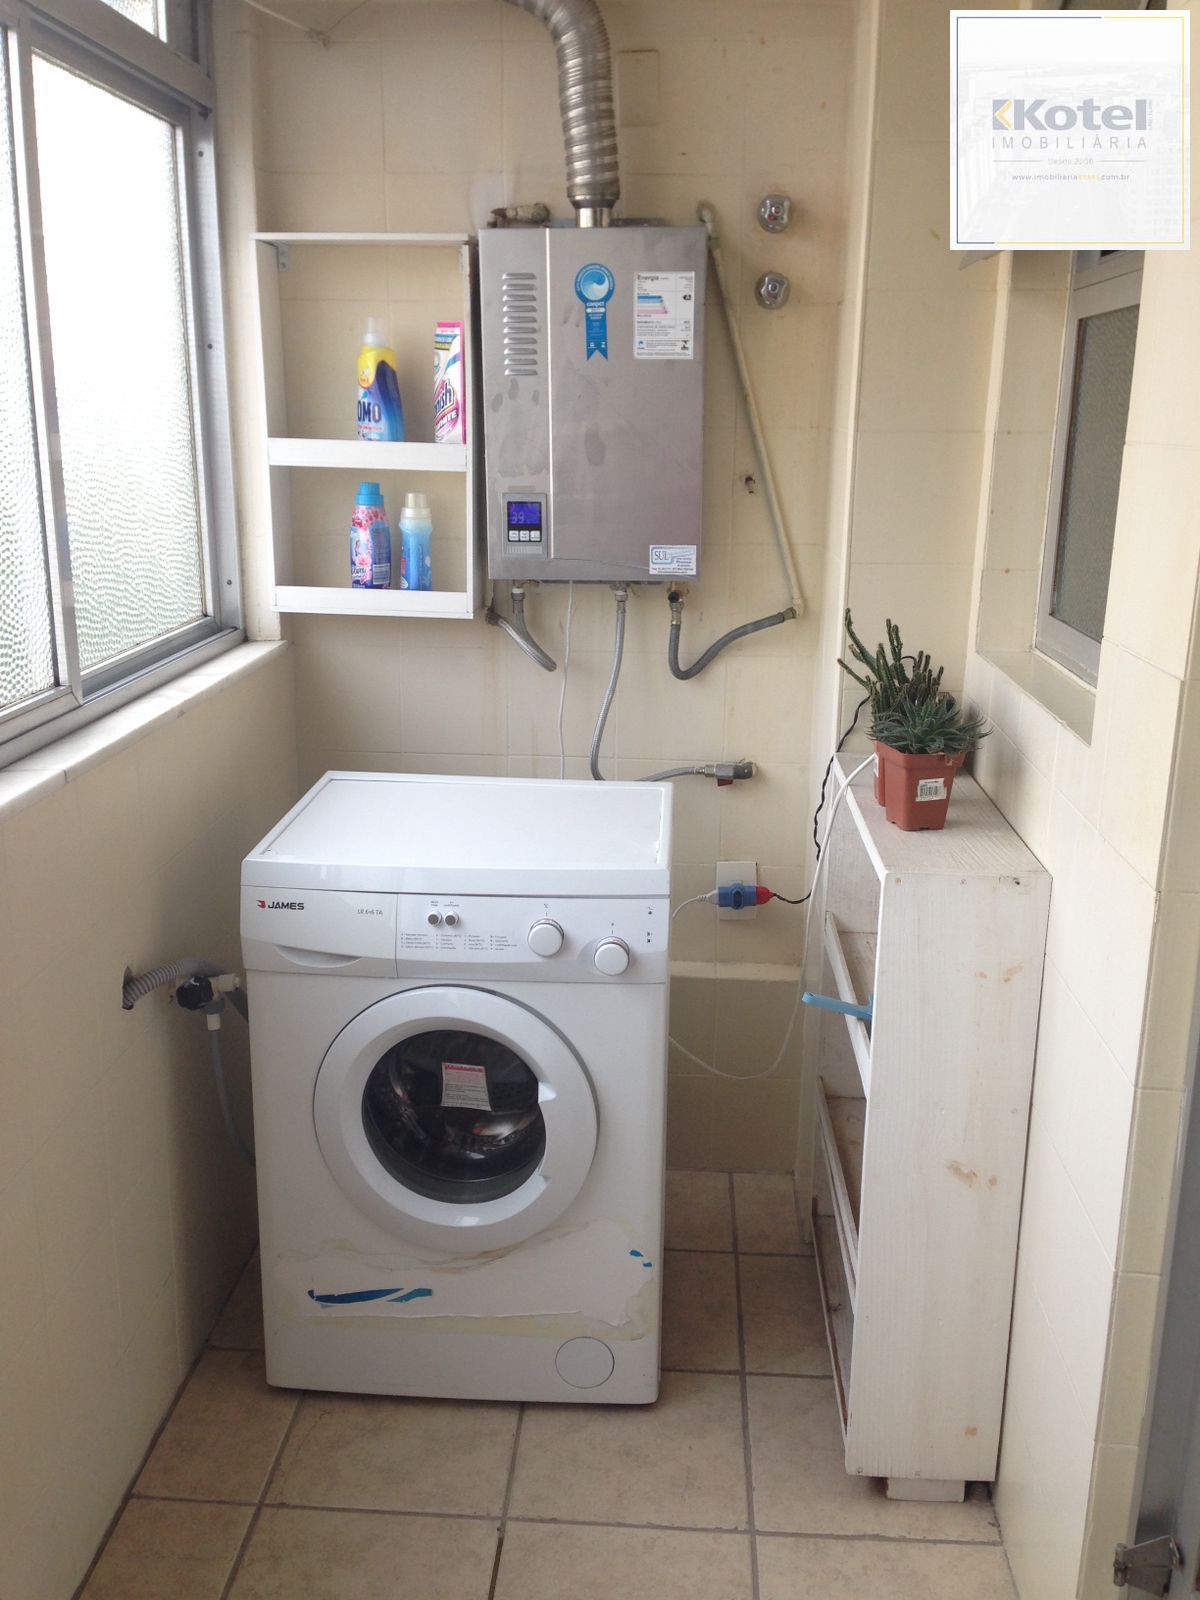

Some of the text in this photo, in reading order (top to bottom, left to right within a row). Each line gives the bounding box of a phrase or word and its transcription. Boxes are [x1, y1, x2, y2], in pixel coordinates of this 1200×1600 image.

[357, 401, 381, 422] OMO
[654, 550, 669, 561] SUL
[268, 901, 305, 911] JAMES
